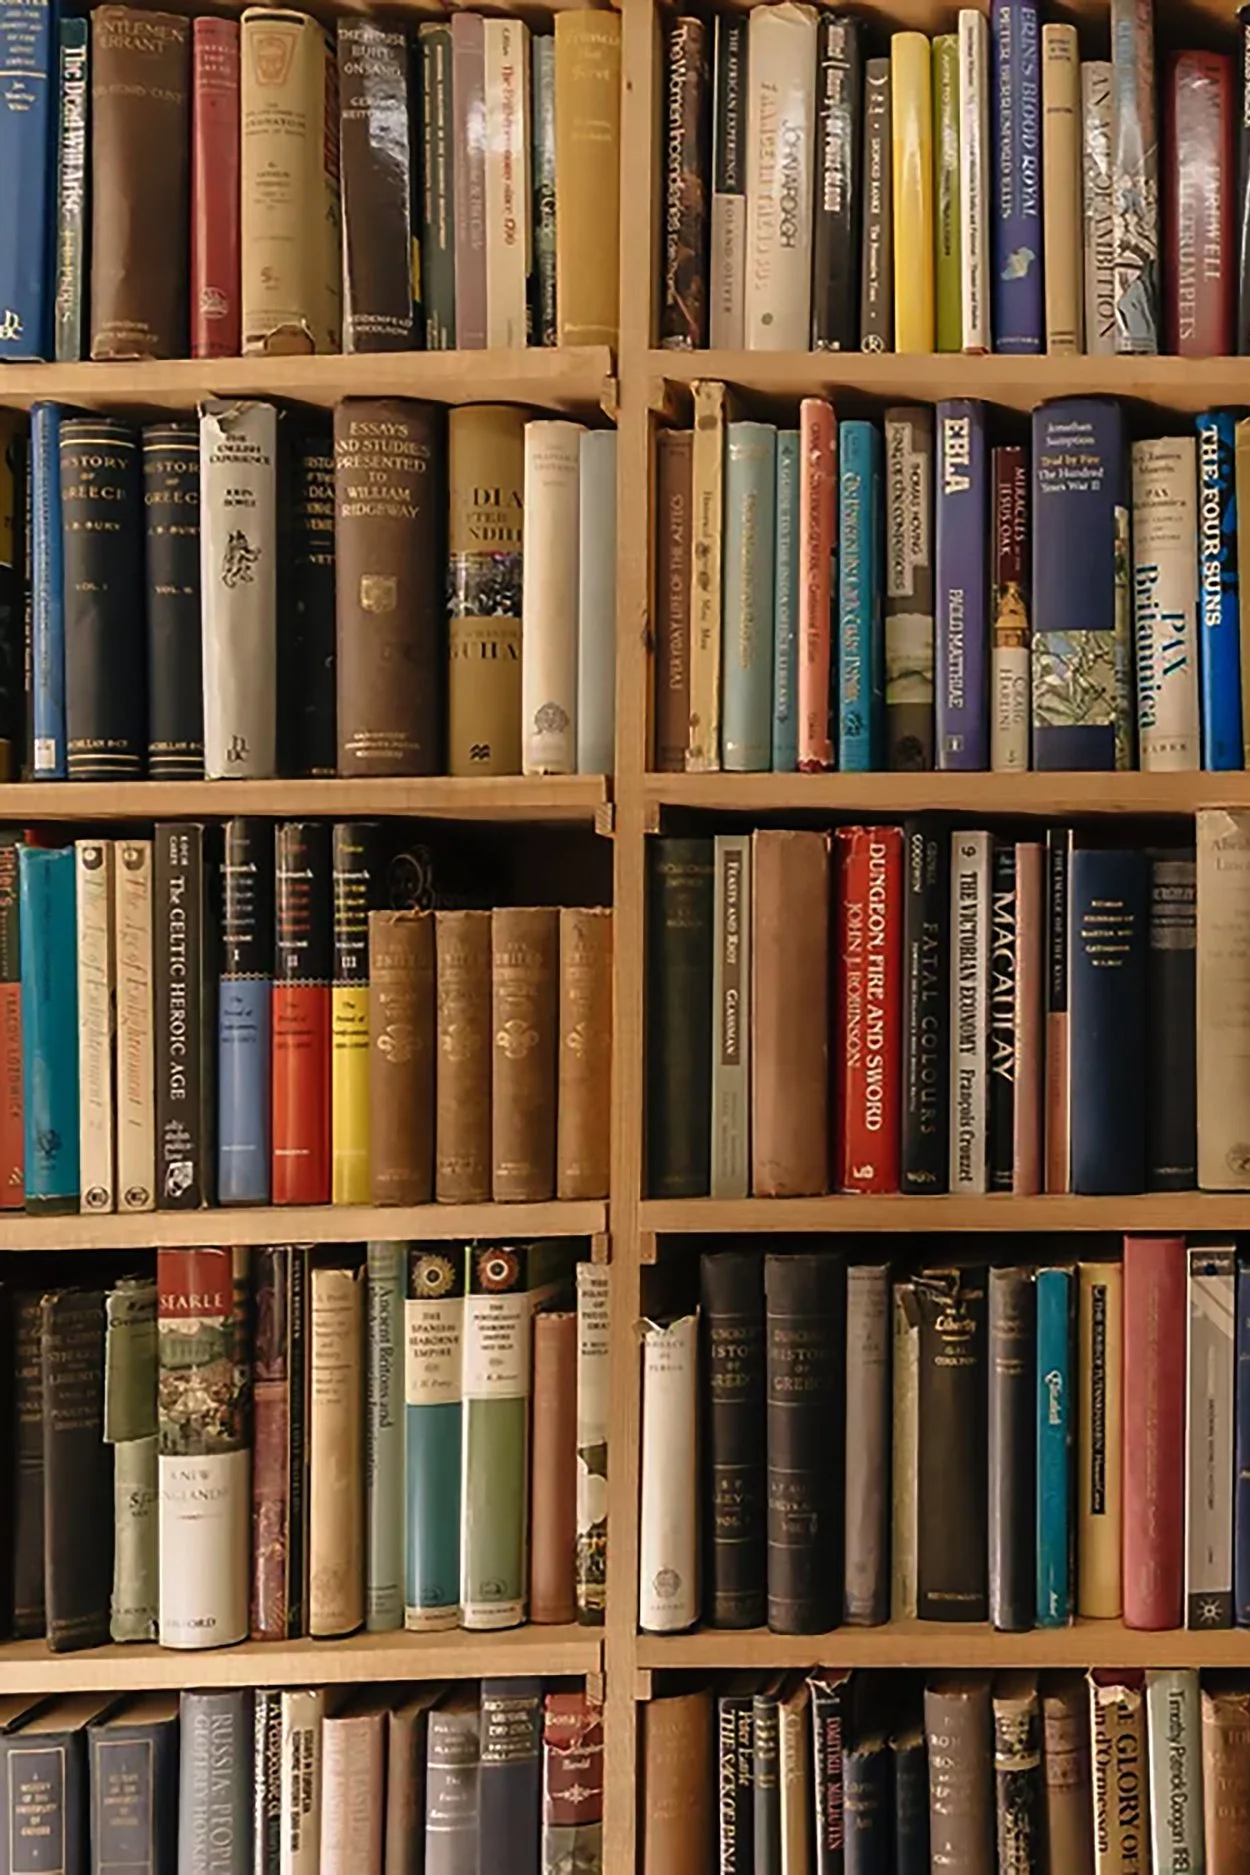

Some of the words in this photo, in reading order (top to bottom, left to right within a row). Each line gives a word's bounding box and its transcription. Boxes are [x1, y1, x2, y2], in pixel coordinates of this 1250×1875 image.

[63, 45, 87, 79] The
[729, 29, 738, 49] THE
[64, 82, 86, 129] Dead
[727, 54, 738, 108] AFRICAN
[1021, 81, 1038, 150] BLOOD
[64, 130, 84, 166] Will
[725, 112, 737, 187] EXPERIENCE
[1021, 154, 1038, 219] ROYAL
[1203, 166, 1221, 283] FAREWELL
[349, 420, 409, 440] ESSAYS
[362, 440, 431, 459] STUDIES
[1046, 421, 1093, 434] Jonathan
[1201, 425, 1219, 481] THE
[335, 455, 426, 475] PRESENTED
[386, 472, 407, 483] TO
[941, 417, 970, 495] EBLA
[345, 486, 411, 503] WILLIAM
[911, 462, 923, 508] THOMAS
[999, 482, 1013, 521] JESUS
[1013, 467, 1026, 541] MIRACLES
[340, 503, 420, 521] RIDGEWAY
[911, 510, 923, 555] HOVING
[1202, 488, 1220, 556] FOUR
[1000, 524, 1013, 556] OAK
[949, 589, 965, 632] PAOLO
[1204, 561, 1222, 627] SUNS
[949, 633, 965, 708] MATTHIAE
[1135, 563, 1161, 730] Britannica
[1161, 612, 1188, 677] PAX
[998, 669, 1014, 732] HARLINE
[1012, 677, 1027, 725] CRAIG
[0, 847, 15, 907] Hitler's
[169, 876, 186, 905] The
[725, 861, 740, 904] FEASTS
[865, 842, 886, 950] DUNGEON,
[959, 871, 977, 900] THE
[169, 908, 185, 978] CELTIC
[726, 907, 739, 933] AND
[844, 900, 863, 953] JOHN
[959, 903, 977, 982] VICTORIAN
[726, 935, 740, 965] RIOT
[920, 922, 938, 1002] FATAL
[867, 954, 884, 1001] FIRE
[991, 891, 1016, 1083] MACAULAY
[170, 983, 185, 1055] HEROIC
[725, 989, 739, 1055] GLASSMAN
[846, 971, 862, 1068] ROBINSON
[866, 1003, 884, 1050] AND
[959, 985, 977, 1056] ECONOMY
[171, 1061, 186, 1100] AGE
[865, 1054, 884, 1132] SWORD
[920, 1016, 938, 1135] COLOURS
[957, 1068, 977, 1128] François
[958, 1130, 977, 1183] Crouzet
[159, 1291, 224, 1310] SEARLE
[379, 1285, 396, 1344] Ancient
[934, 1316, 976, 1333] Liberty
[379, 1346, 396, 1398] Britons
[379, 1400, 395, 1428] and
[738, 1711, 754, 1745] Peter
[1166, 1689, 1186, 1745] Timothy
[210, 1714, 234, 1797] RUSSIA:
[738, 1748, 753, 1788] Earle
[1116, 1733, 1141, 1830] GLORY
[1168, 1745, 1187, 1791] Patrick
[209, 1803, 234, 1875] PEOPL
[1167, 1792, 1188, 1844] Coogan
[1119, 1834, 1139, 1864] OF
